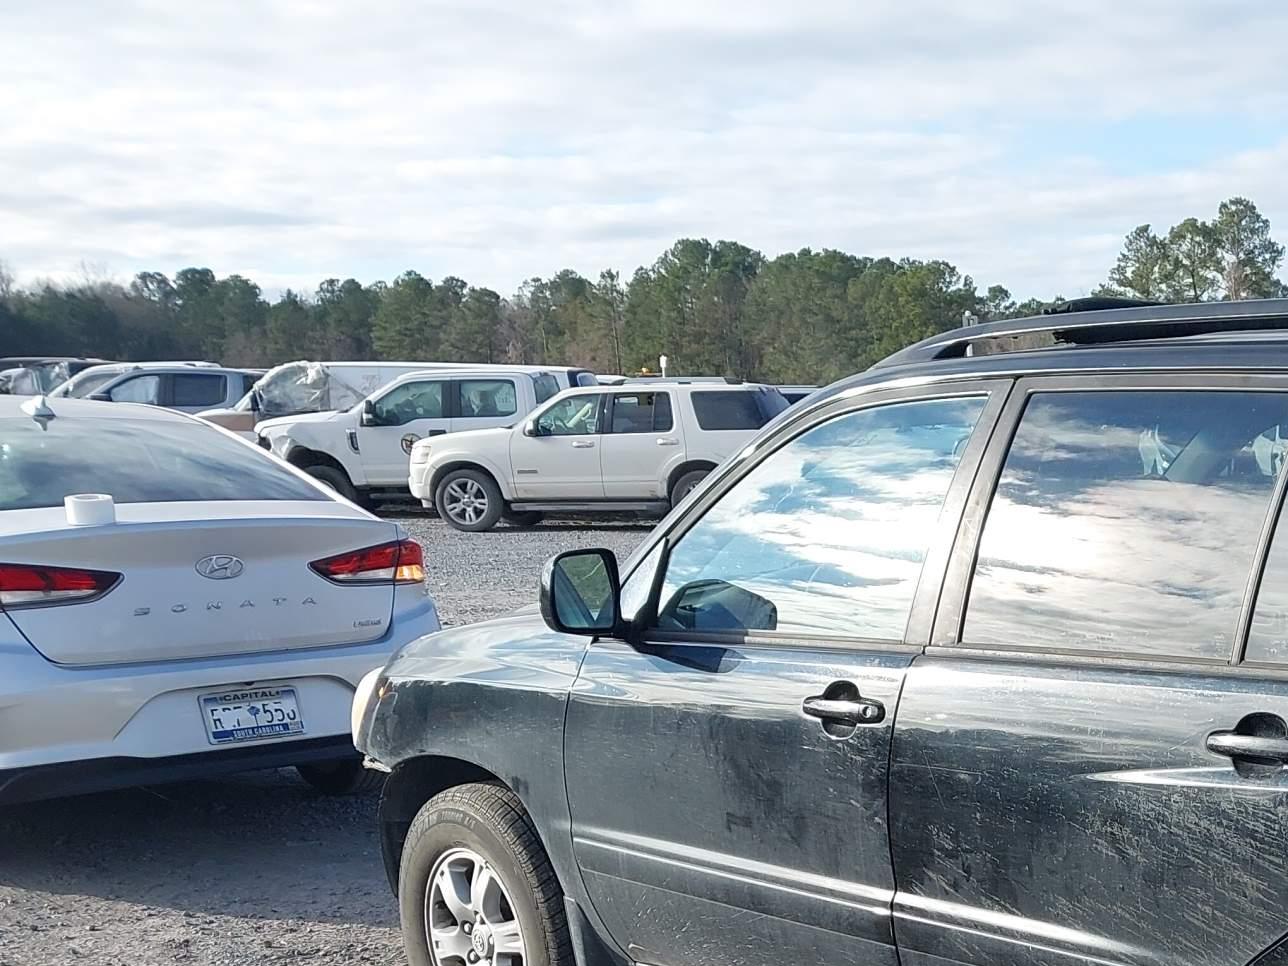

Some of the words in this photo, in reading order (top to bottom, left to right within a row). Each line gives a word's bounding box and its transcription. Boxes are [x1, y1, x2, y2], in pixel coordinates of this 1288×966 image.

[133, 596, 318, 617] SONATA
[223, 690, 276, 702] CAPITAL
[232, 727, 254, 738] SOUTH
[254, 724, 284, 736] CAROLINA
